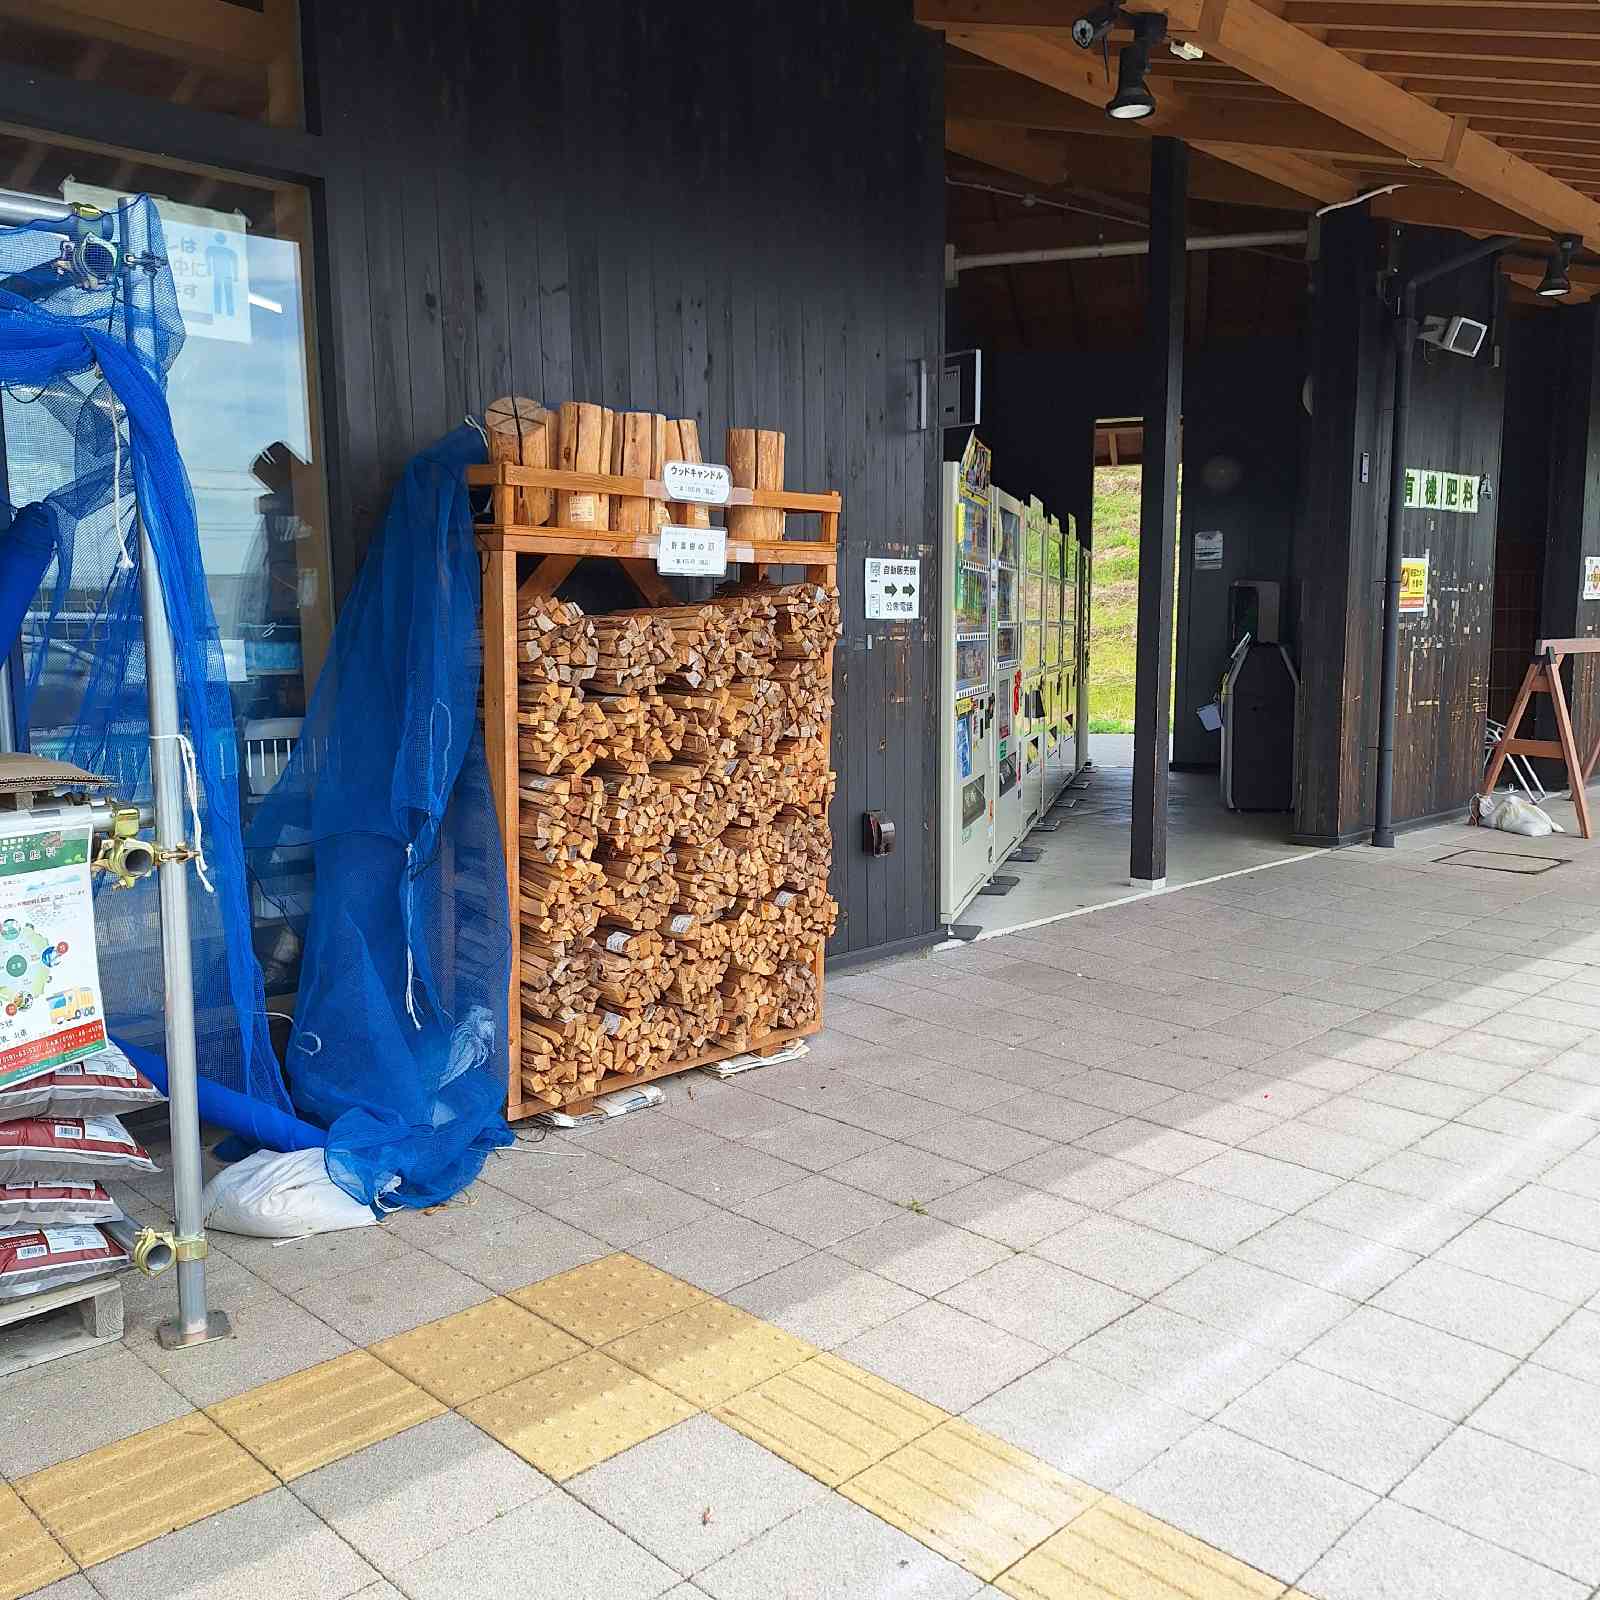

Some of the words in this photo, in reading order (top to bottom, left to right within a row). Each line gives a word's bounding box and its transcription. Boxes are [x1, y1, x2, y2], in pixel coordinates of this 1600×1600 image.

[671, 465, 723, 481] ウッドキャンドル
[1405, 472, 1474, 509] 有機肥料
